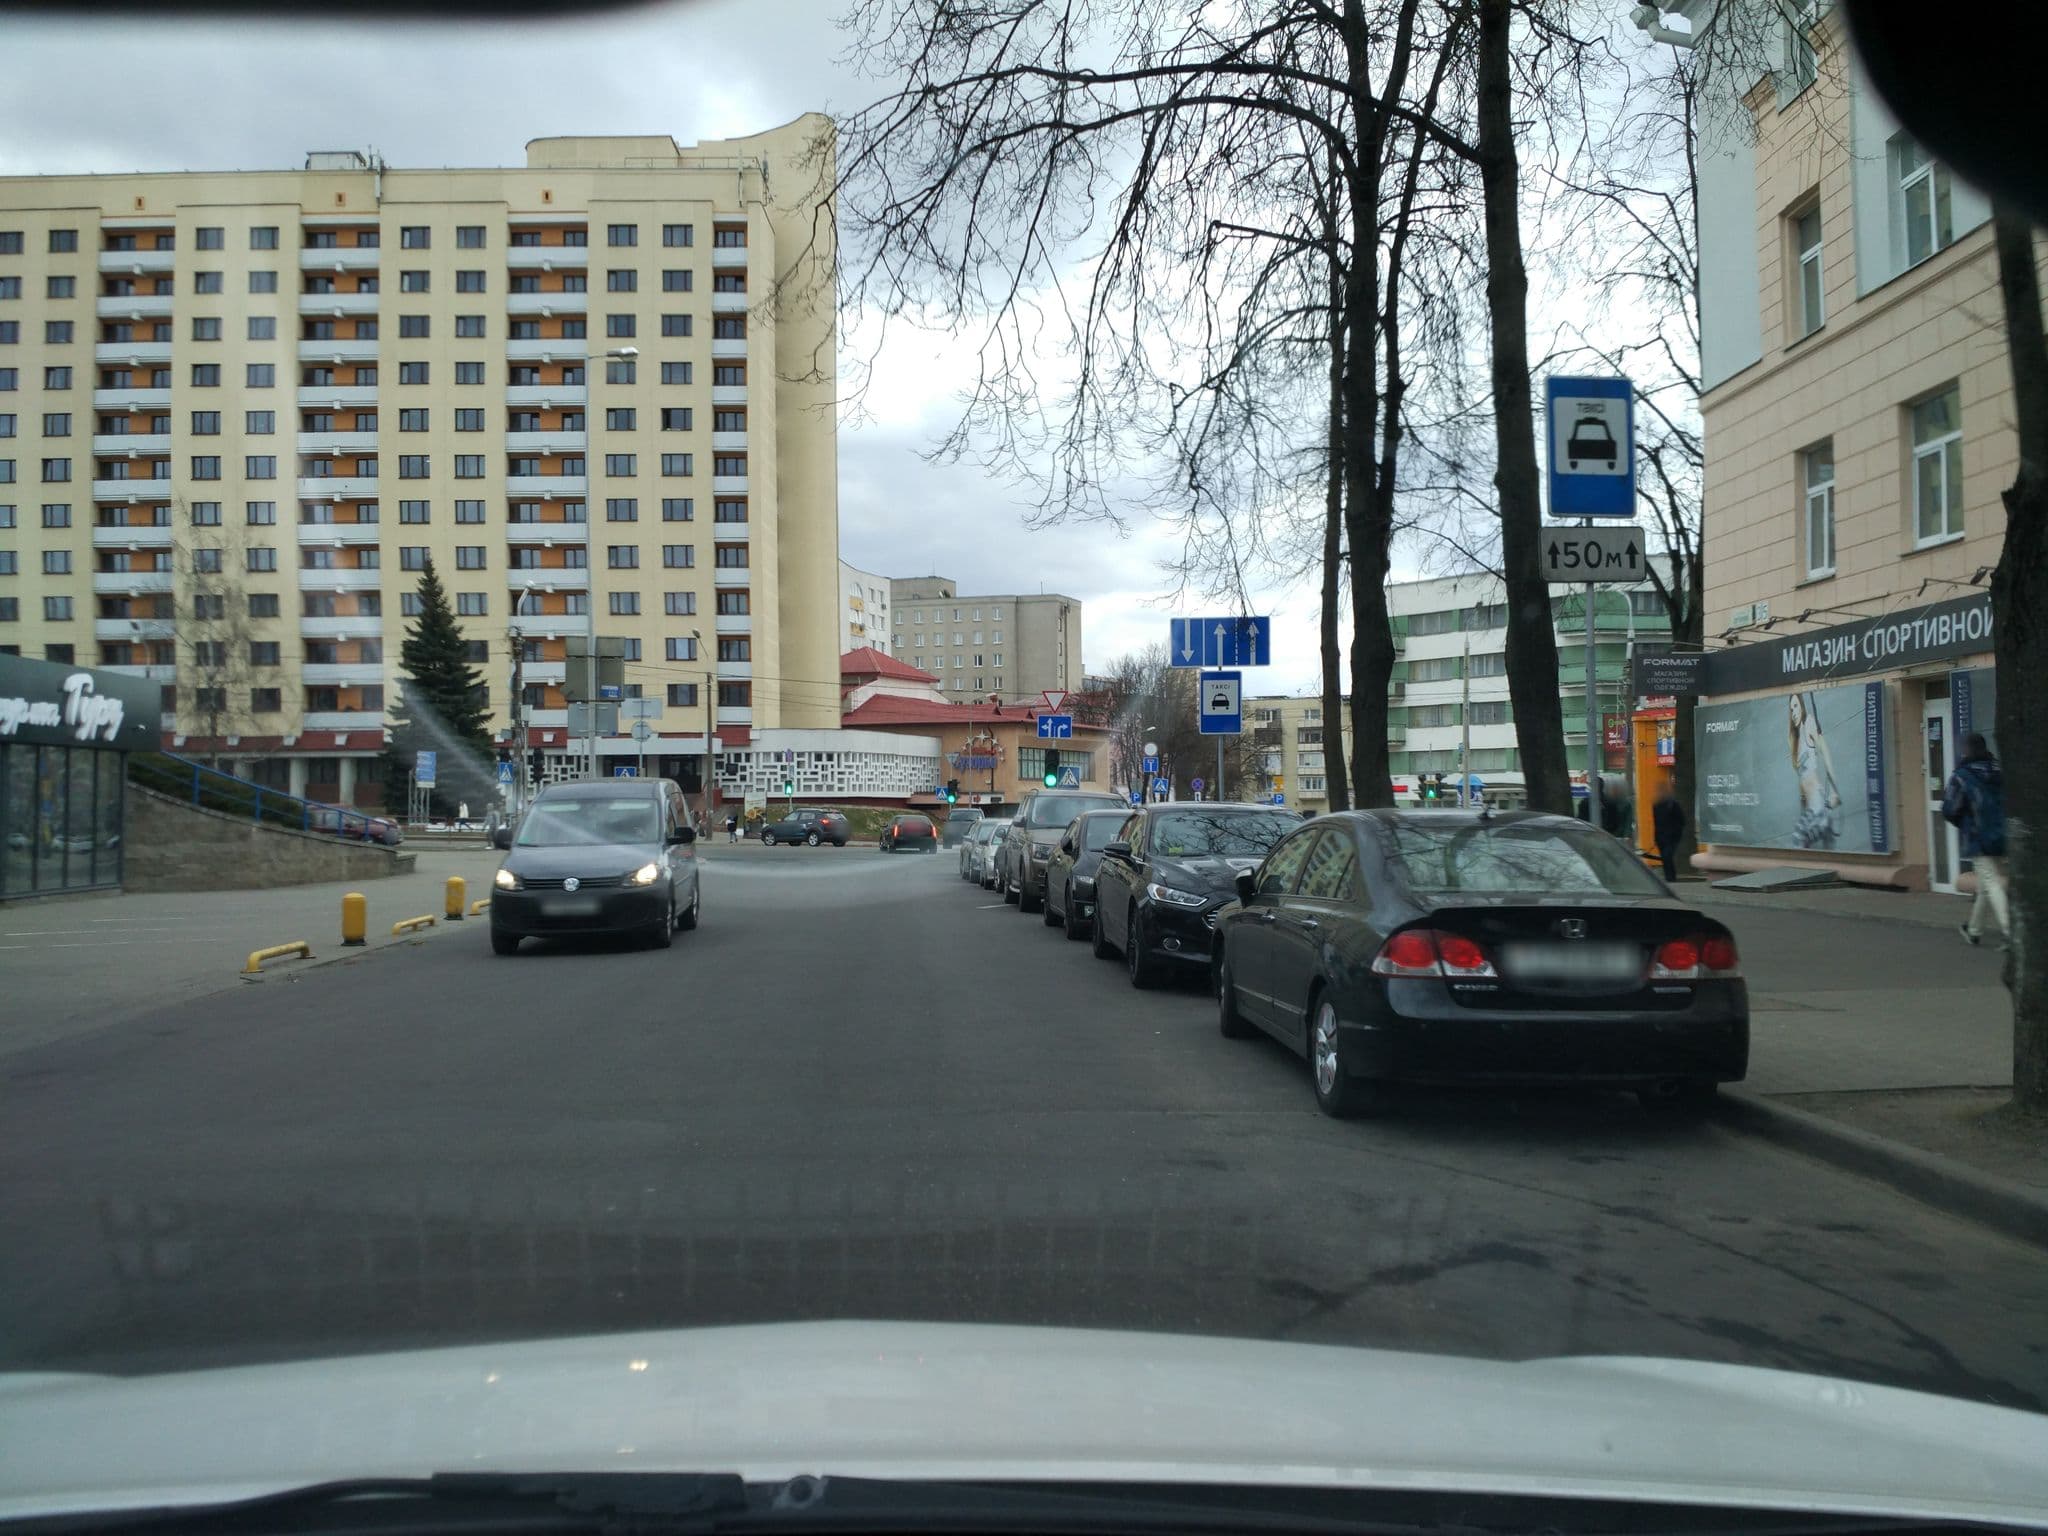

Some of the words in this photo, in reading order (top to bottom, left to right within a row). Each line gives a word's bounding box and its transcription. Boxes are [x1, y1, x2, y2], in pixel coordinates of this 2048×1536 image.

[1782, 634, 1856, 673] МАГАЗИН
[1863, 597, 1994, 659] СПОРТИВНОЙ
[1642, 658, 1700, 666] FORMAT
[1705, 720, 1740, 733] FORMAT
[1867, 691, 1879, 772] КОЛЛЕКЦИЯ
